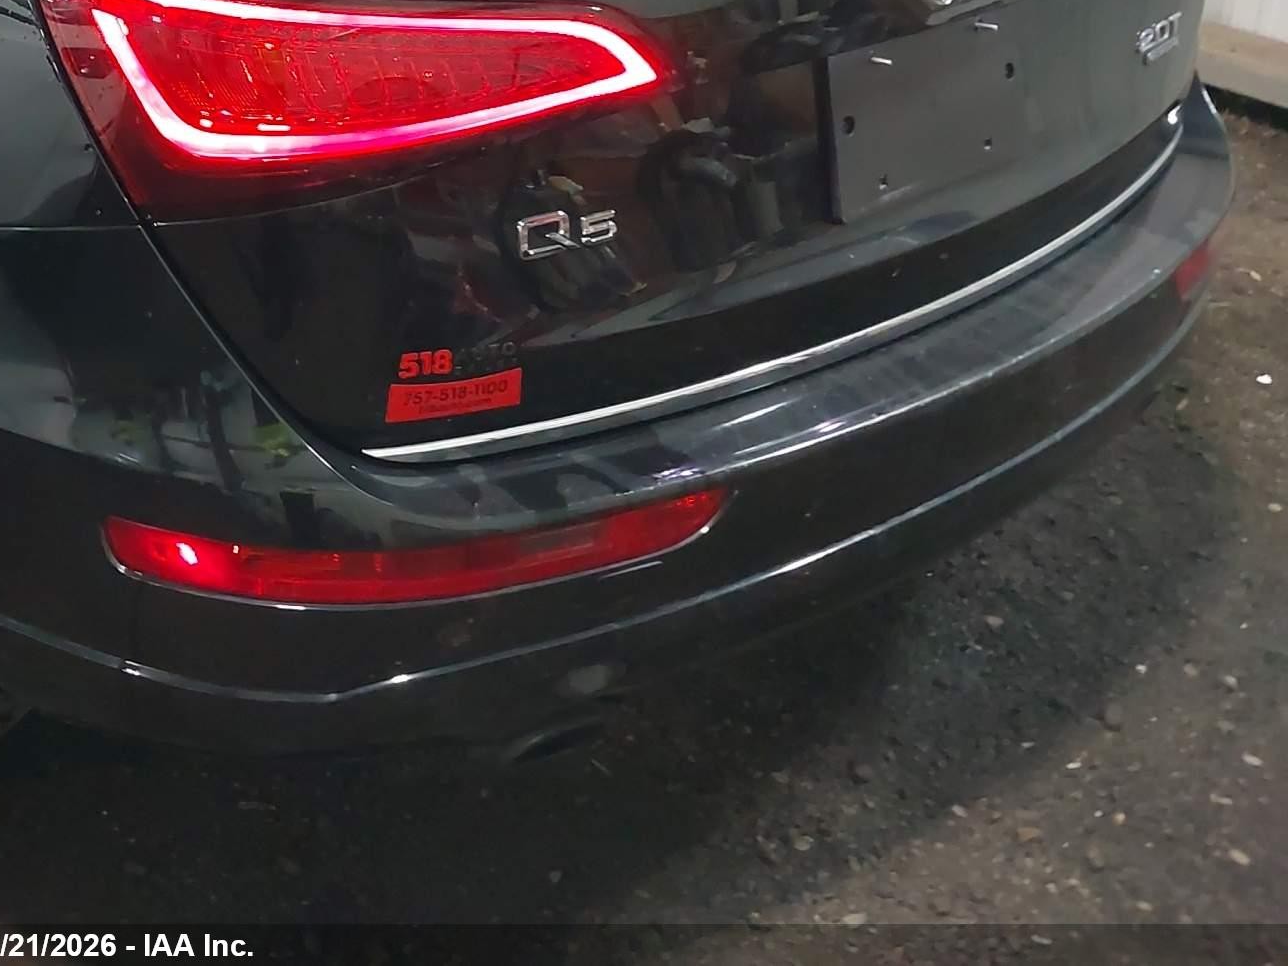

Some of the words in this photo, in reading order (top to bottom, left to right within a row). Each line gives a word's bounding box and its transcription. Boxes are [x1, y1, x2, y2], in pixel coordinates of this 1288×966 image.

[516, 210, 617, 260] Q5
[398, 349, 453, 379] 518
[403, 380, 508, 406] 757-518-1100
